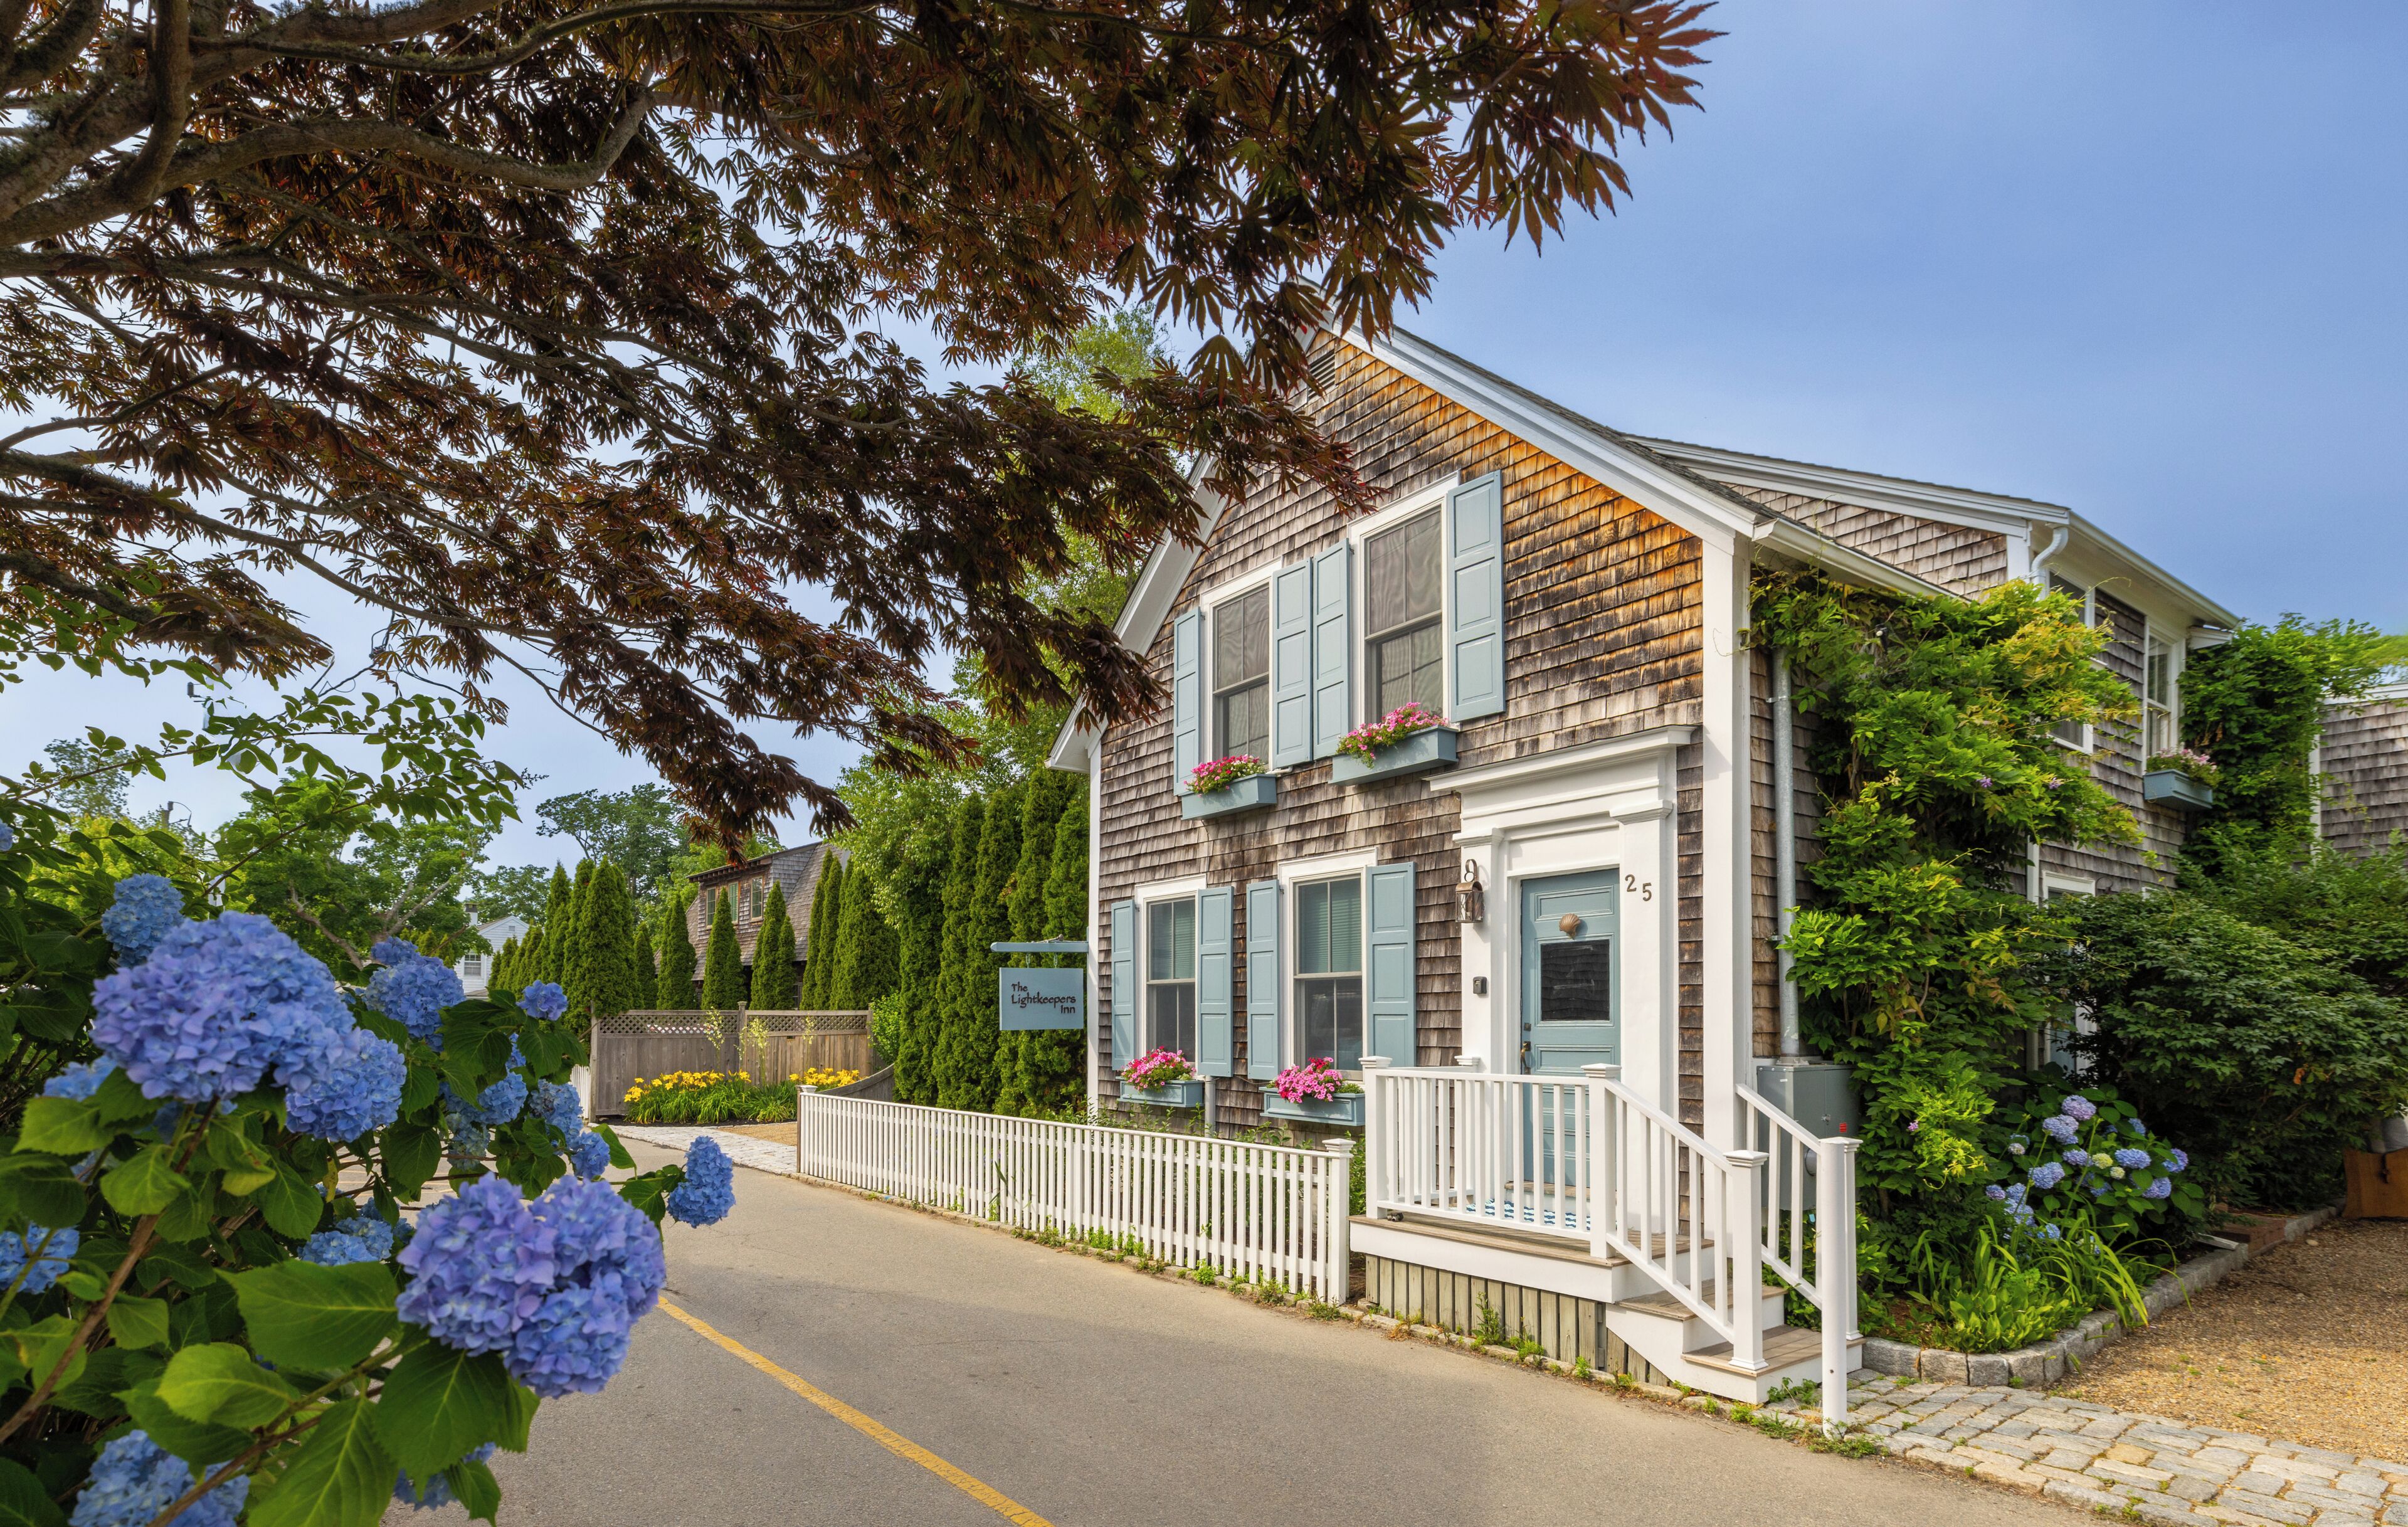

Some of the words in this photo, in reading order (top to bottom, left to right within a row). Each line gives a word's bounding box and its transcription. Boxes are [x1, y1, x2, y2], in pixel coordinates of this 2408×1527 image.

[1625, 874, 1652, 901] 25
[1011, 981, 1028, 991] The
[1011, 991, 1076, 1008] Lightkeepers
[1060, 1005, 1075, 1014] Inn
